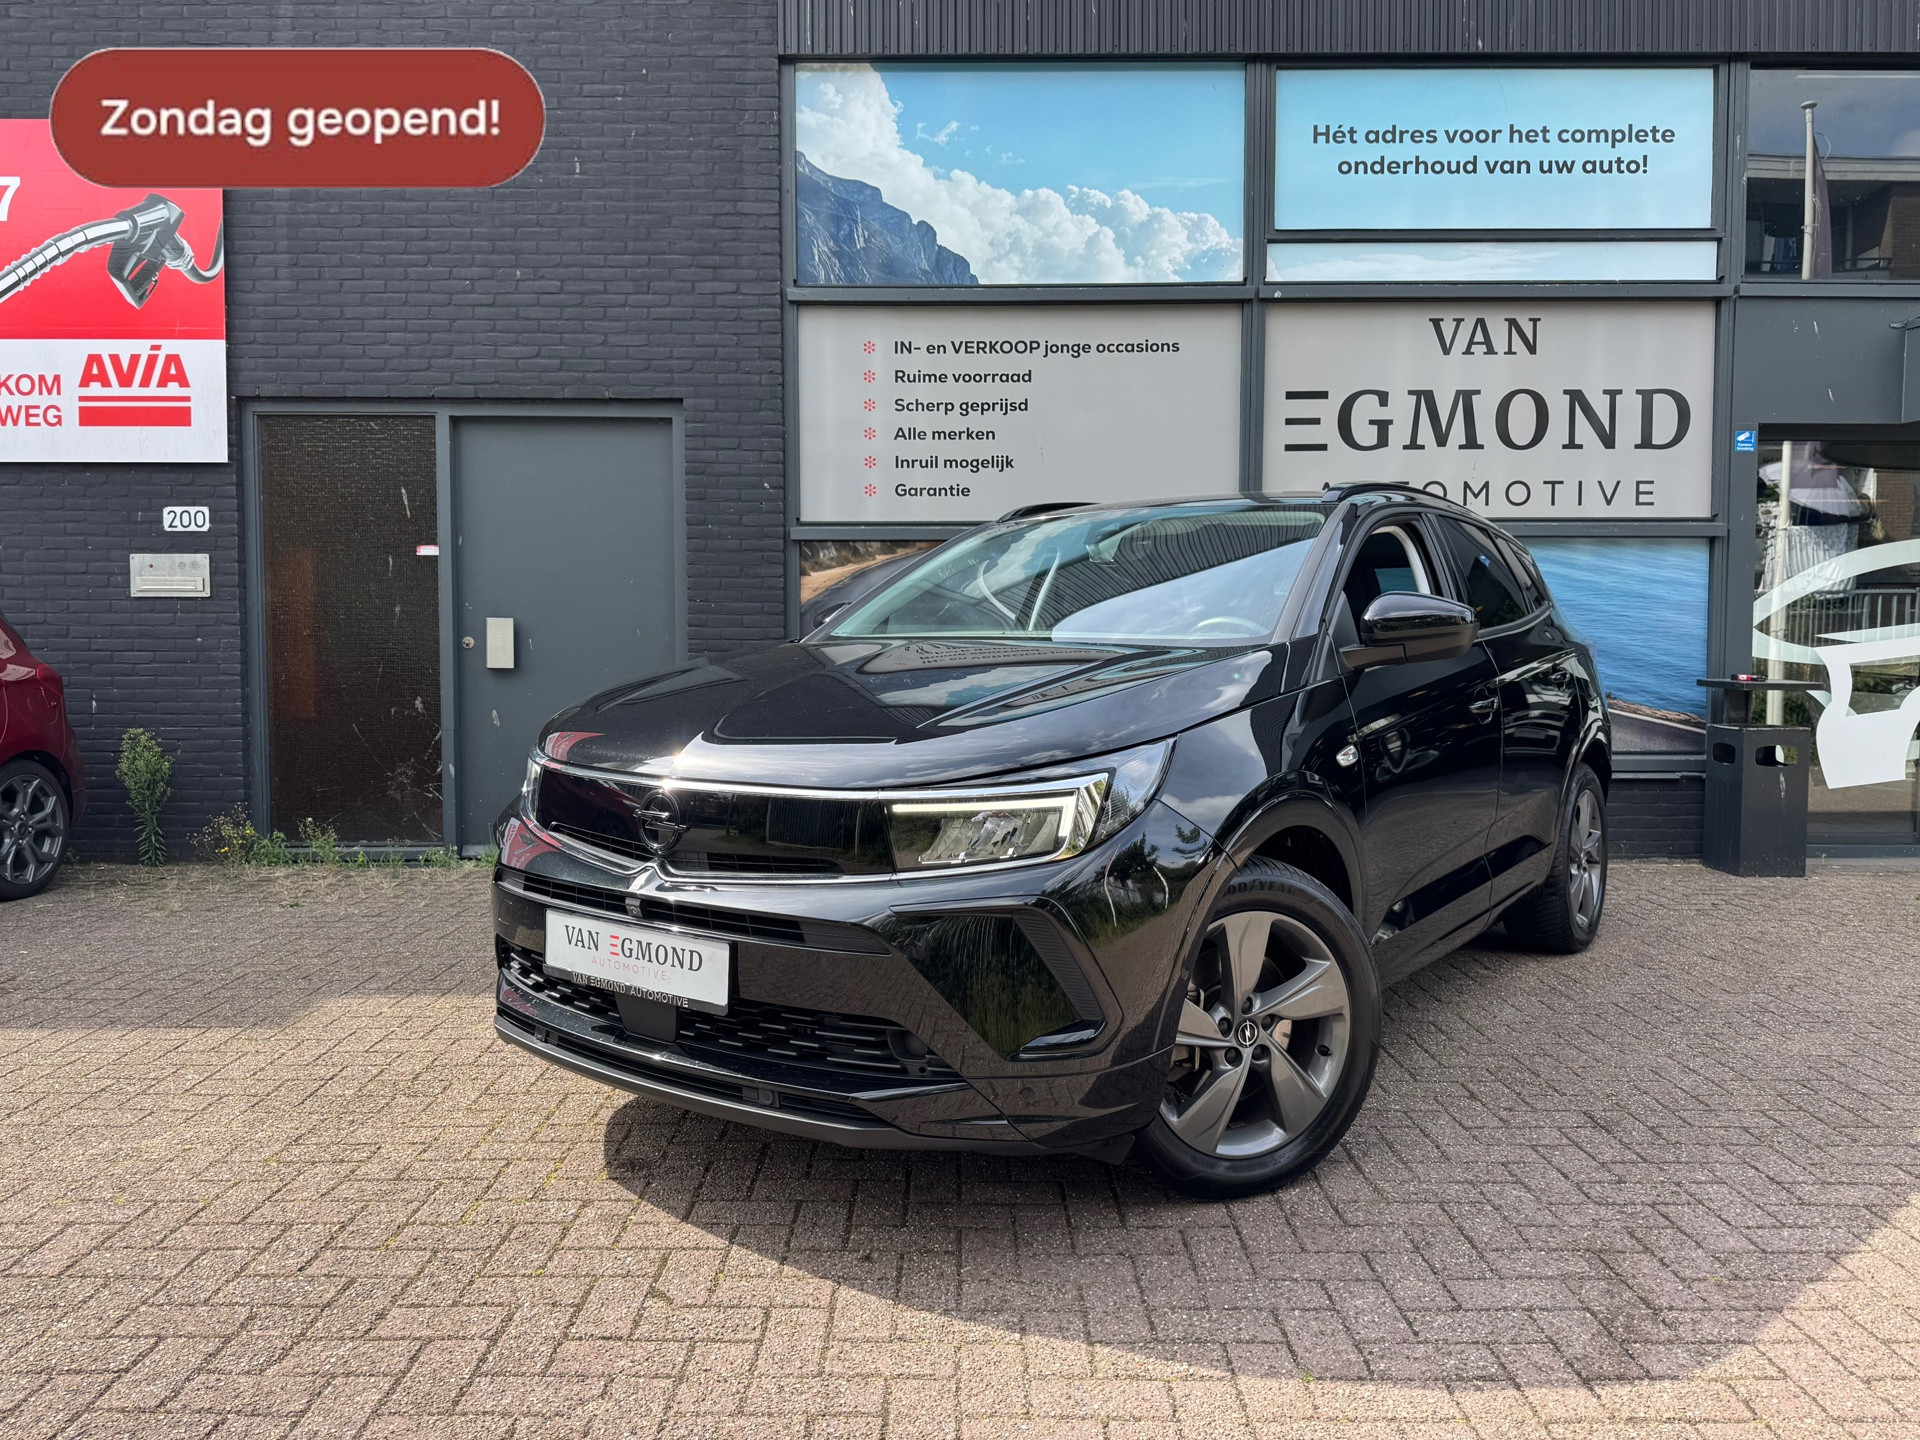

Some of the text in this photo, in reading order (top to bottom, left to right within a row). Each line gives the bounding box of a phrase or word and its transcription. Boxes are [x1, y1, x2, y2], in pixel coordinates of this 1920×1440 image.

[1312, 123, 1676, 149] Hét adres voor het complete
[1337, 154, 1649, 175] onderhoud van uw auto!
[1428, 317, 1542, 356] VAN
[894, 338, 1181, 359] IN- en VERKOOP jonge occasions
[894, 369, 1032, 384] Ruime voorraad
[894, 397, 1029, 416] Scherp geprijsd
[1284, 388, 1691, 452] EGMOND
[893, 426, 996, 441] Alle merken
[894, 454, 1015, 474] Inruil mogelijk
[894, 483, 971, 498] Garantie
[166, 510, 207, 529] 200
[564, 924, 704, 972] VAN EGMOND
[591, 955, 668, 981] AUTOMOTIVE
[572, 972, 589, 985] VAN
[630, 986, 689, 1008] AUTOMOTIVE
